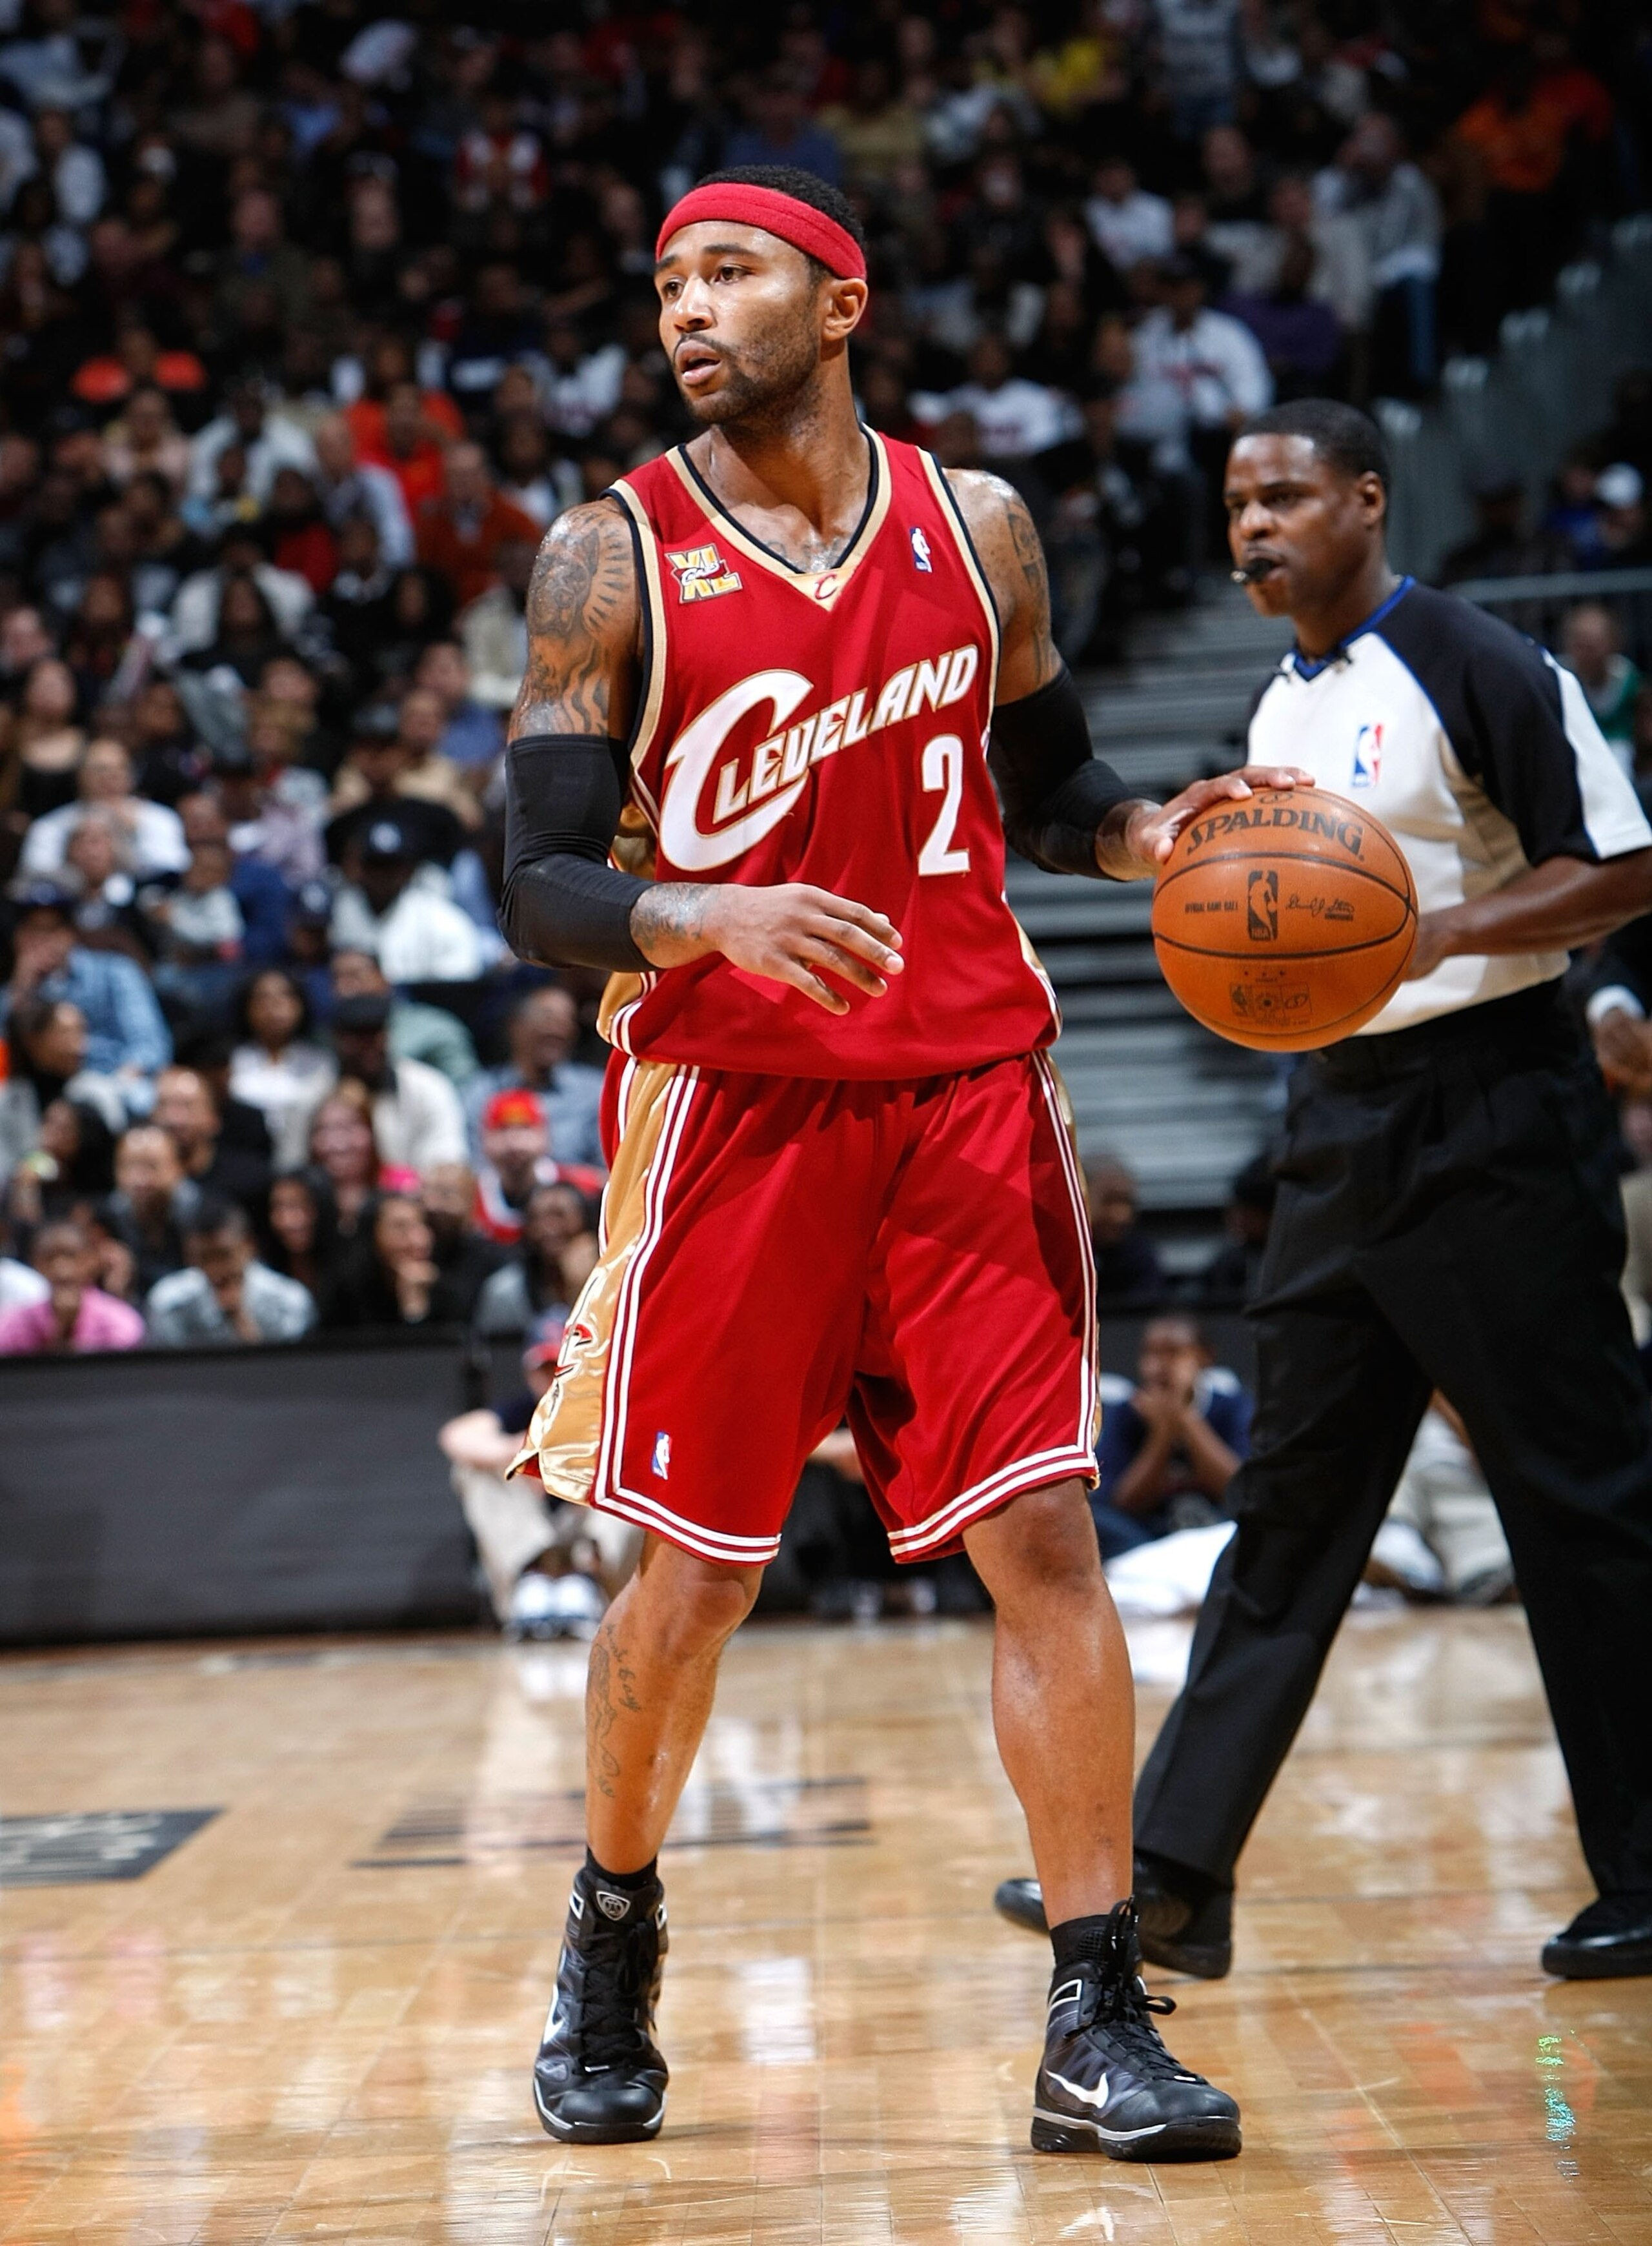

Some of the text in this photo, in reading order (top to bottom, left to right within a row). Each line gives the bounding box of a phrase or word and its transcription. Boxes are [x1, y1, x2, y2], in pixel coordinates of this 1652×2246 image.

[659, 643, 978, 871] CLEVELAND
[918, 733, 971, 876] 2
[1187, 808, 1364, 857] SPALDING
